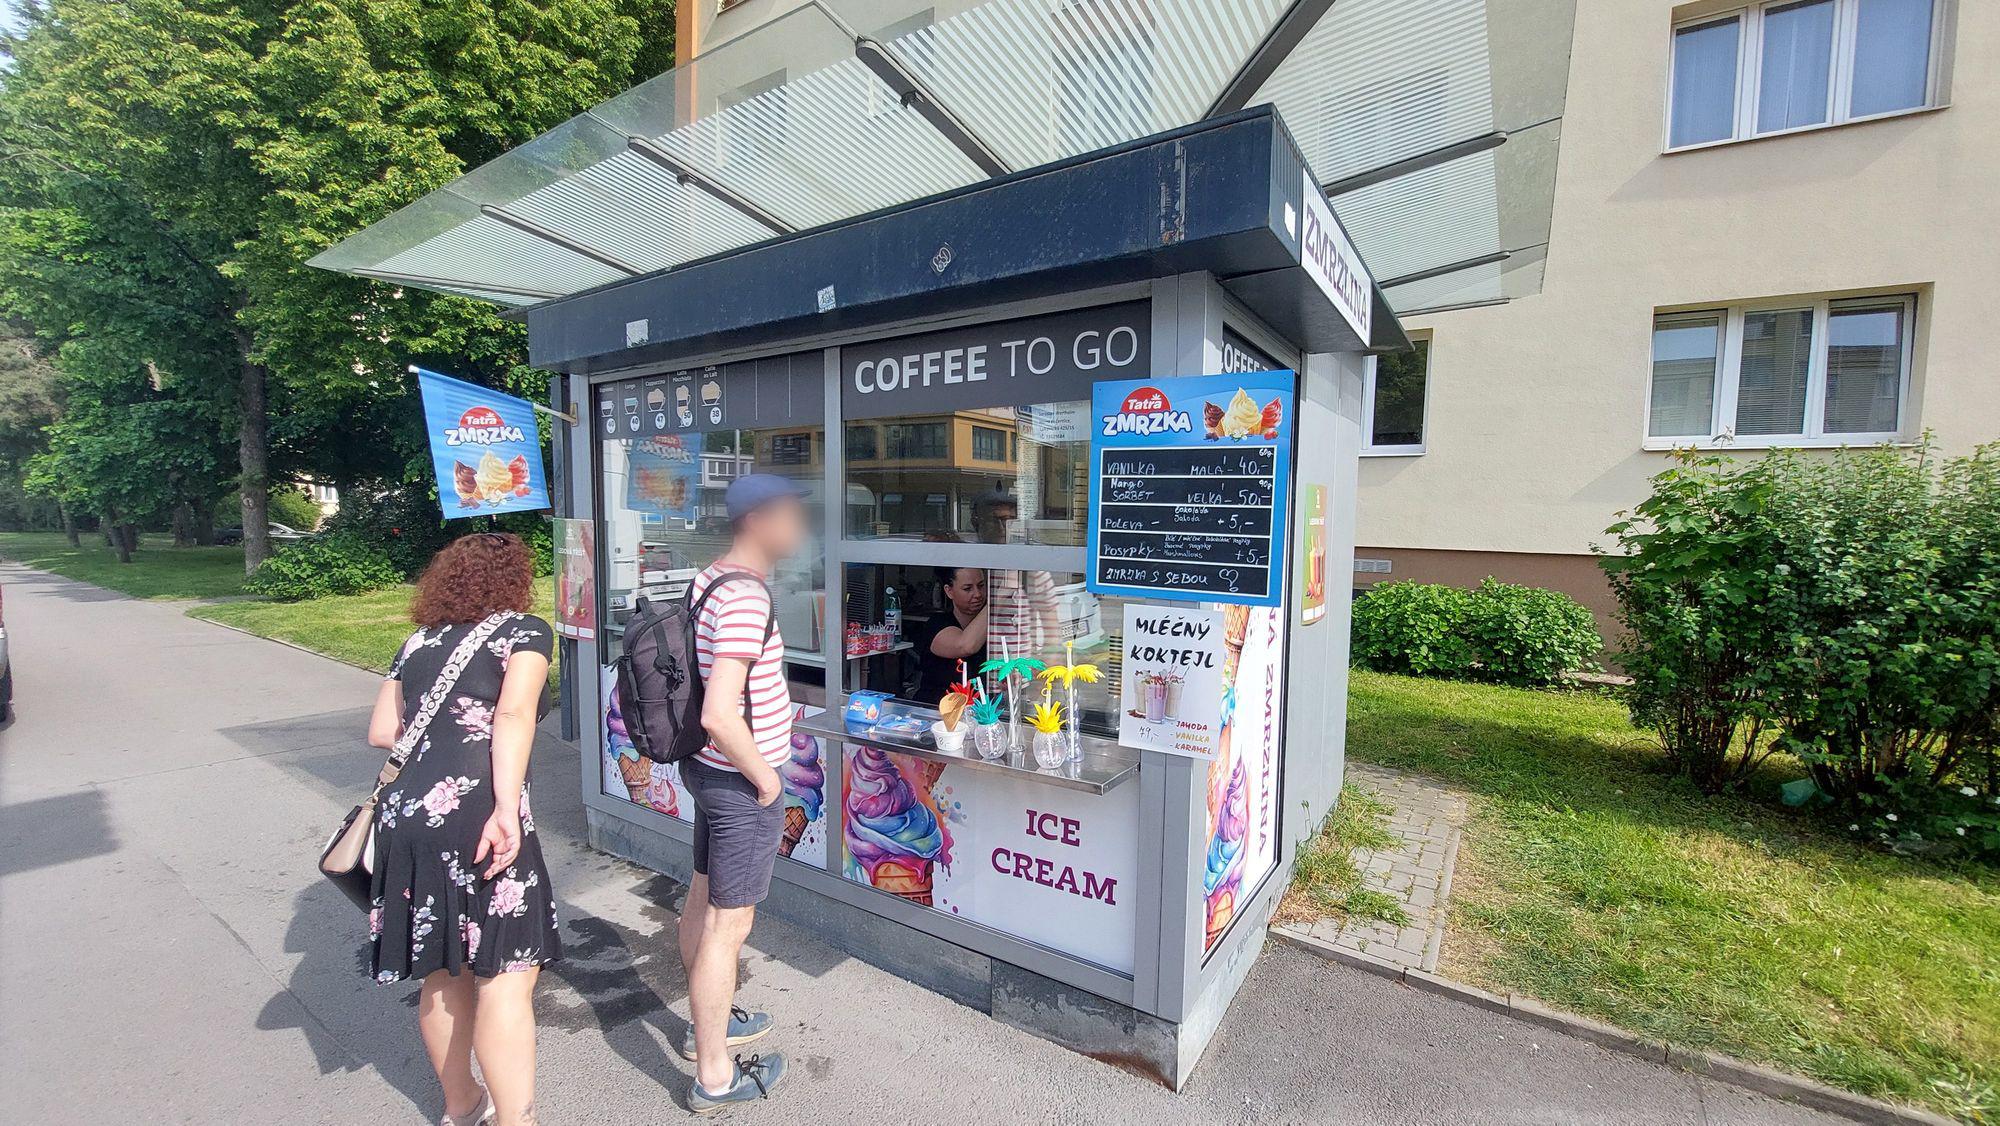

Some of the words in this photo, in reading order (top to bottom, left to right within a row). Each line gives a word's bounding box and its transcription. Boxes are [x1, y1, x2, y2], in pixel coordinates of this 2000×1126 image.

[1305, 203, 1368, 331] ZMRZLINA
[854, 345, 988, 394] COFFEE
[1001, 336, 1056, 377] TO
[1072, 326, 1138, 370] GO
[1128, 398, 1162, 410] Tatra
[465, 415, 497, 425] Tatra
[1103, 411, 1192, 436] ZMRZKA
[445, 426, 525, 446] ZMRZKA
[1107, 461, 1155, 475] VANILKA
[1135, 615, 1211, 641] MLÉČNÝ
[1130, 645, 1214, 669] KOKTEJL
[1176, 720, 1208, 731] JAHODA
[1176, 732, 1210, 743] VANILKA
[1174, 742, 1212, 754] KARAMEL
[1259, 663, 1274, 857] ZMRZLINA
[1026, 809, 1080, 847] ICE
[992, 847, 1118, 906] CREAM
